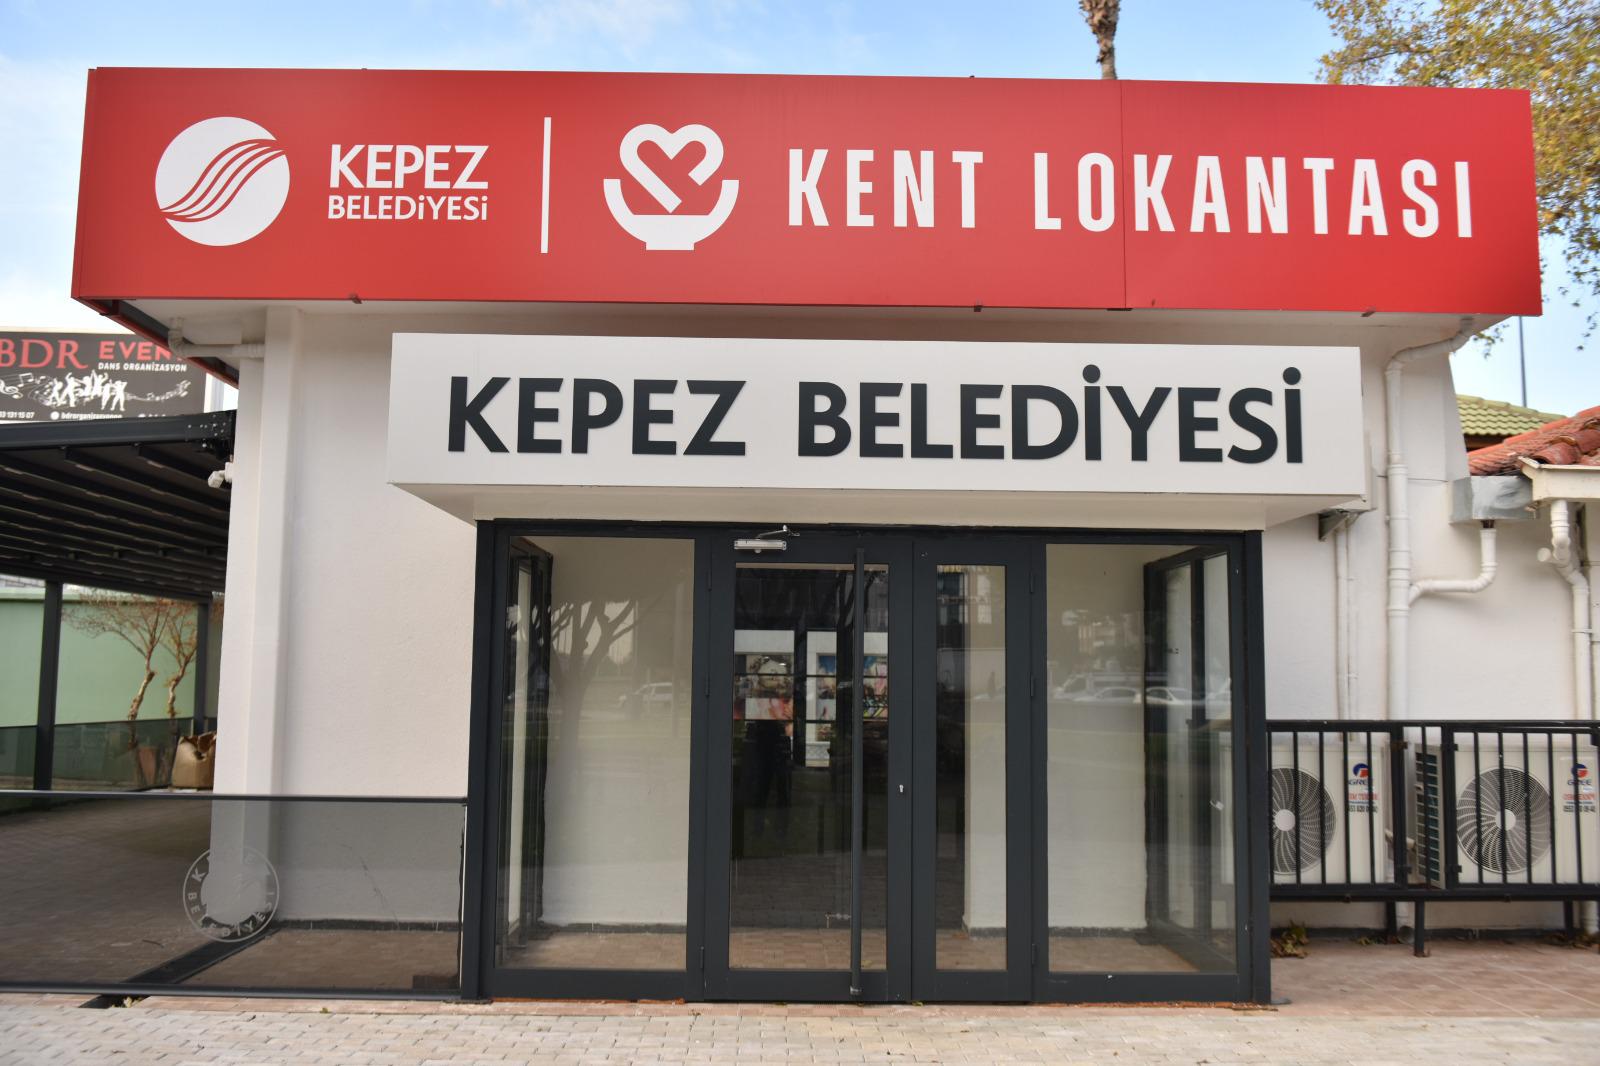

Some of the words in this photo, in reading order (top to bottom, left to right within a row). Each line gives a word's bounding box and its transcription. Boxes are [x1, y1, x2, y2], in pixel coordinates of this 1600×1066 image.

[329, 143, 489, 190] KEPEZ
[788, 148, 984, 229] KENT
[1033, 152, 1473, 238] LOKANTASI
[0, 338, 88, 369] BDR
[99, 340, 181, 361] EVEN
[98, 362, 121, 371] DANS
[447, 376, 747, 457] KEPEZ
[797, 364, 1303, 464] BELEDİYESİ
